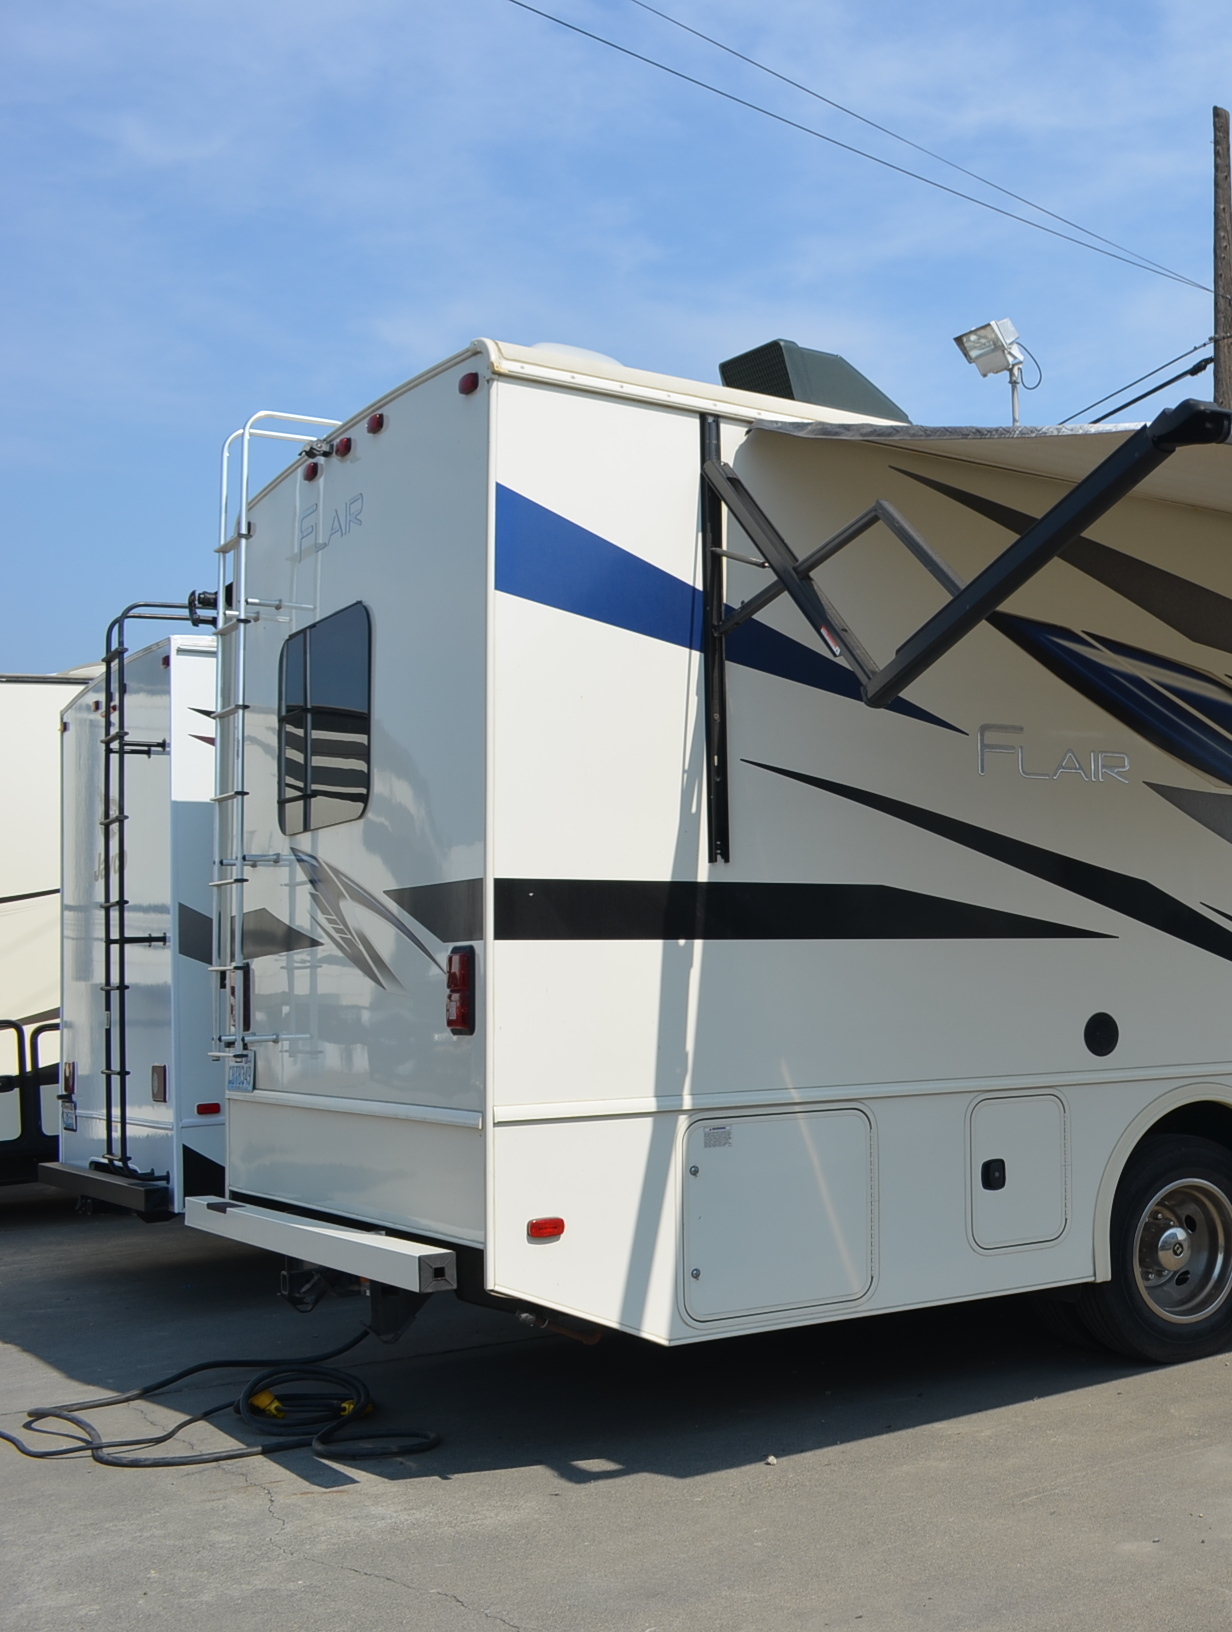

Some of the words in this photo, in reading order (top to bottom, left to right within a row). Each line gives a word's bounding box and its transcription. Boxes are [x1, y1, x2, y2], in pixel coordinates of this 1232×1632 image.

[299, 492, 364, 564] FLAIR
[977, 723, 1130, 784] FLAIR
[94, 850, 128, 882] Jac
